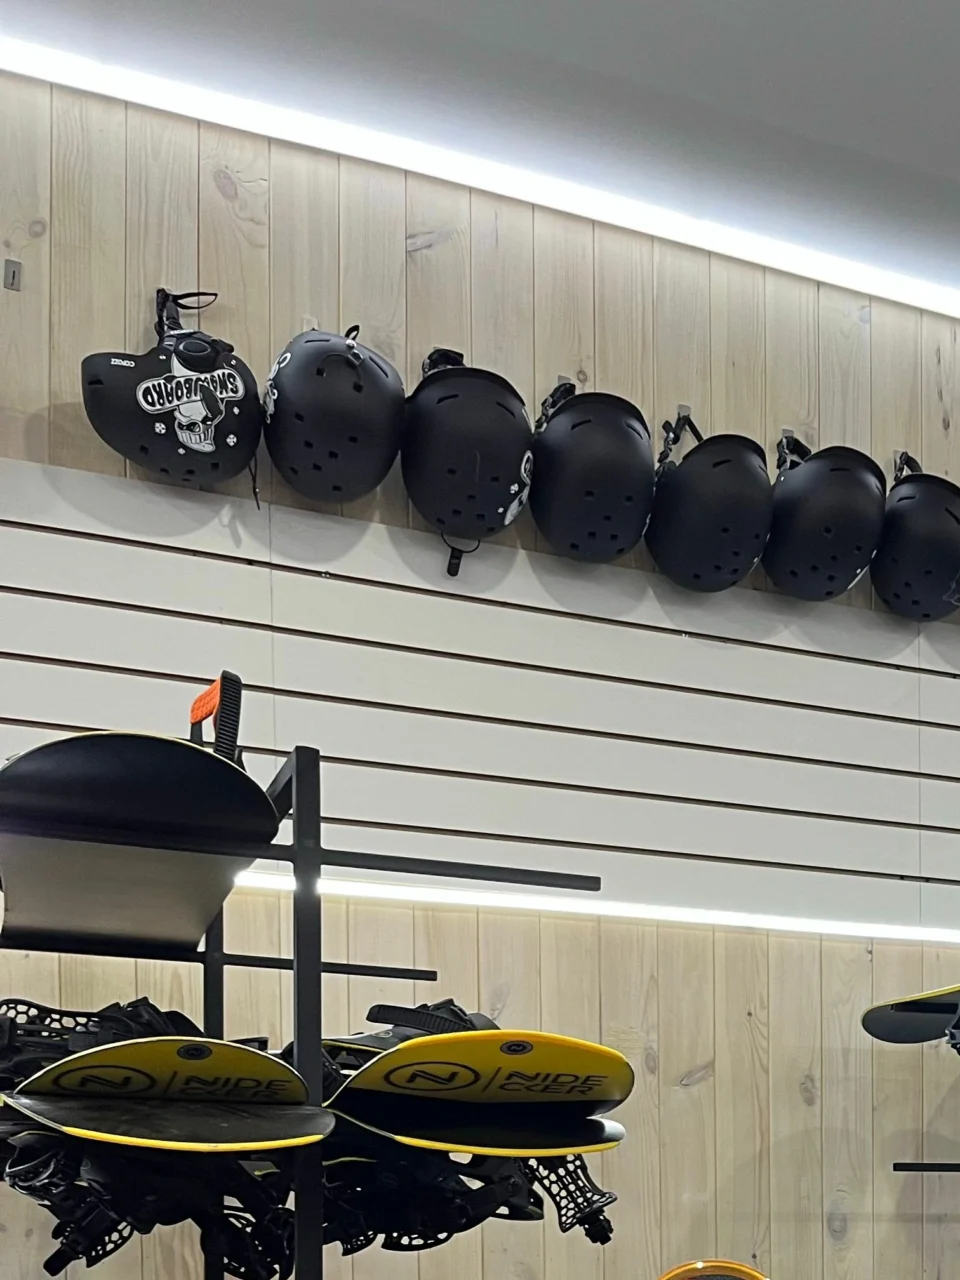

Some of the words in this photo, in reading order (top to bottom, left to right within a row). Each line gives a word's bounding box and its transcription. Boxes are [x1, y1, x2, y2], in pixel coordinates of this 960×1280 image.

[141, 371, 241, 408] SNOWBOARD
[182, 1074, 294, 1091] NIDE
[503, 1070, 609, 1087] NIDE
